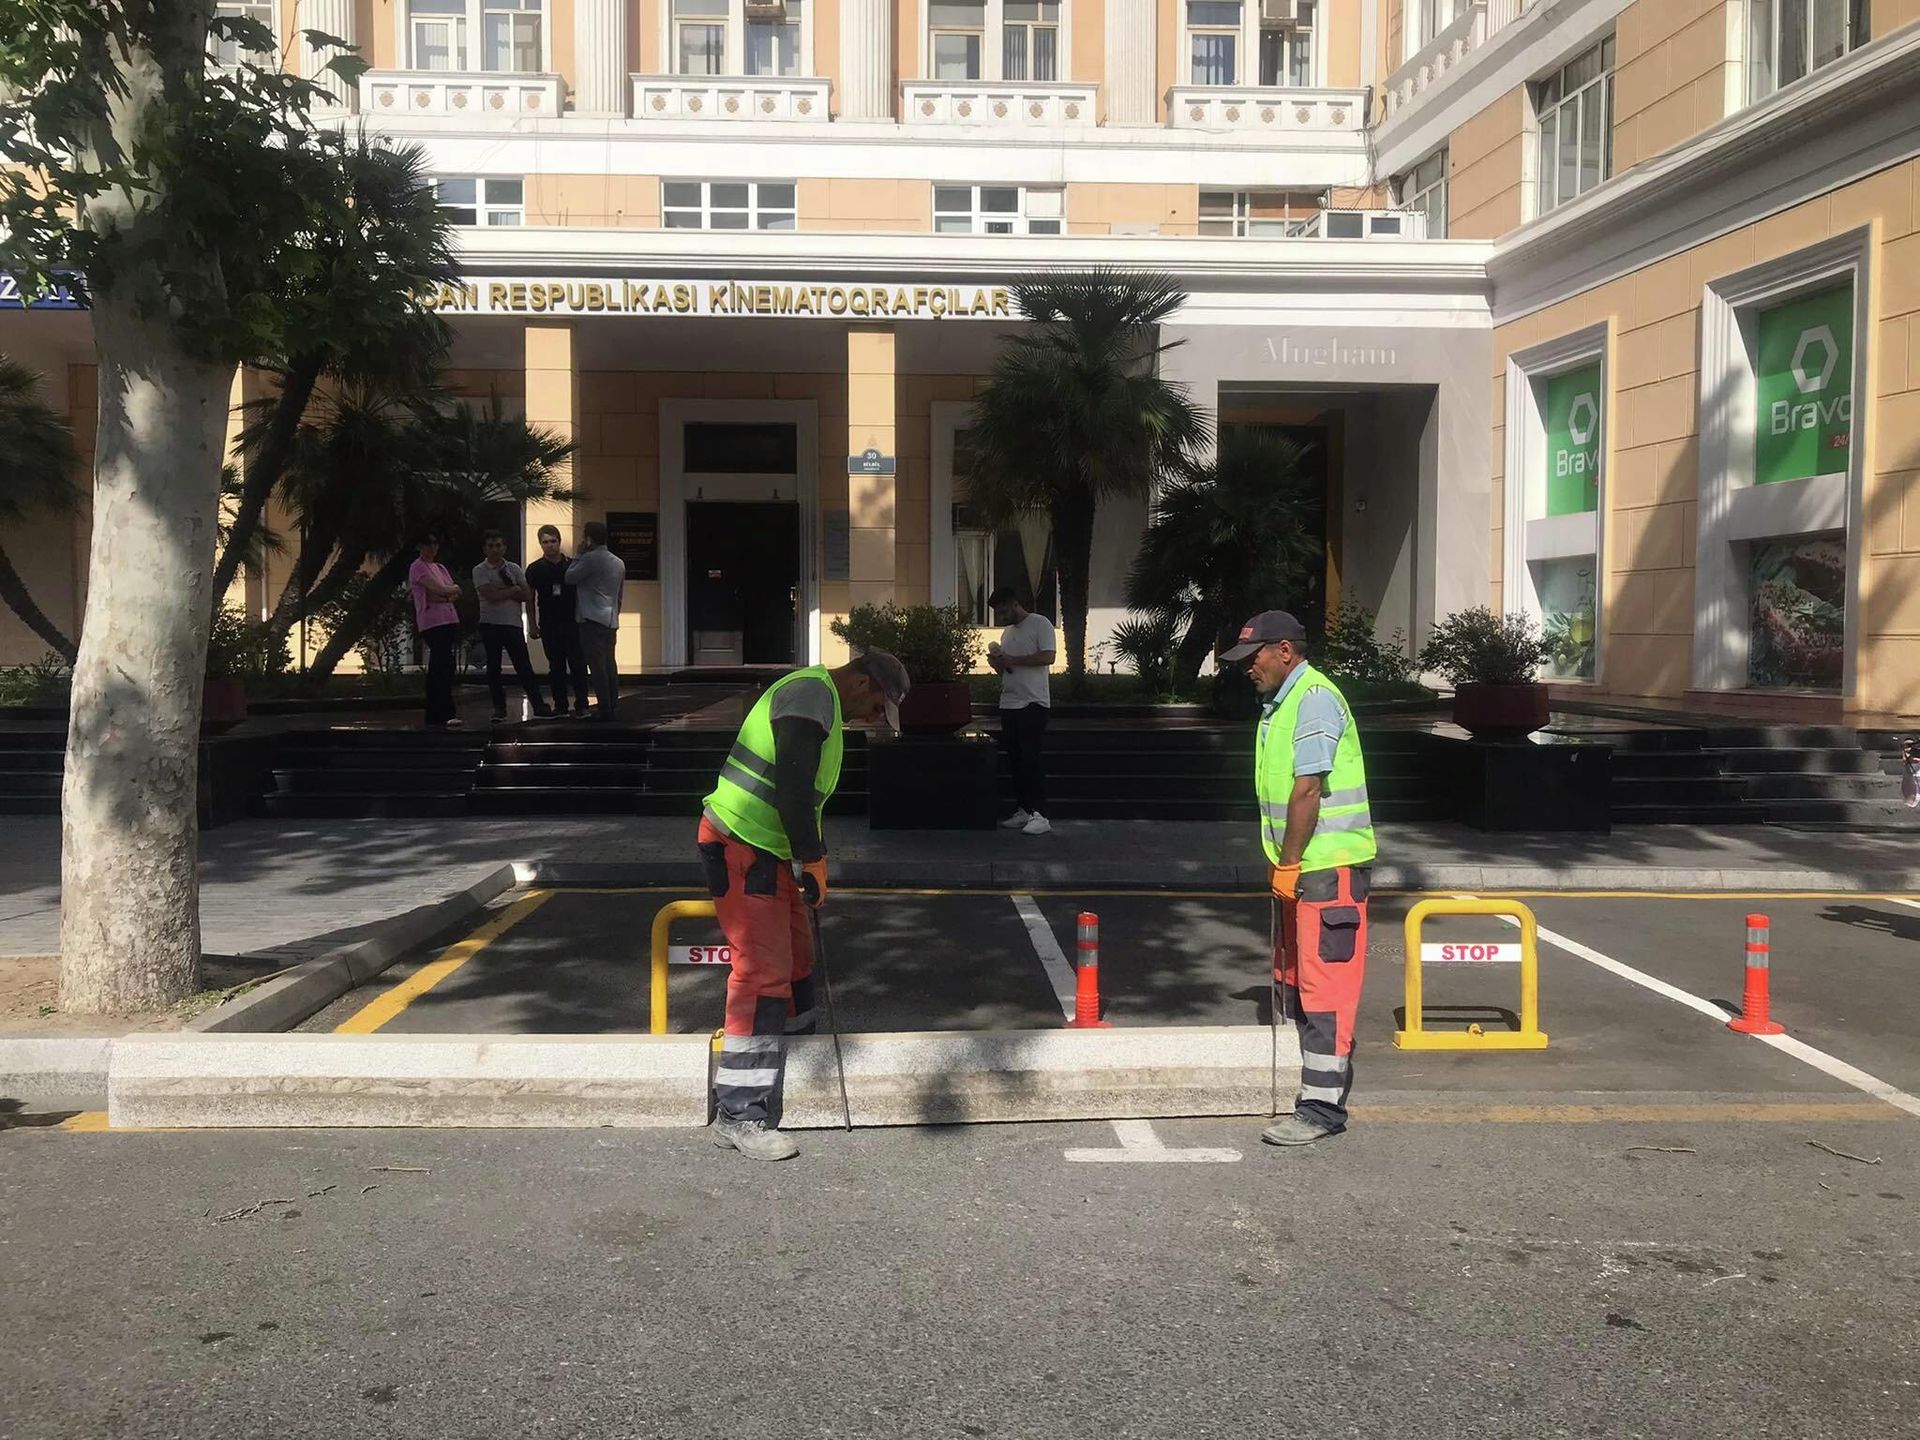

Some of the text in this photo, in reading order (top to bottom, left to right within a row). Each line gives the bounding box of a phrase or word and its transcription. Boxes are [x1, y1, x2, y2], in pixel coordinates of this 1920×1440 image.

[488, 278, 697, 313] RESPUBLİKASI
[708, 279, 1010, 320] KİNEMATOQRAFÇILAR
[1262, 335, 1396, 366] Mugham
[1556, 449, 1598, 477] Brav
[688, 947, 732, 963] STO
[1441, 945, 1499, 960] STOP
